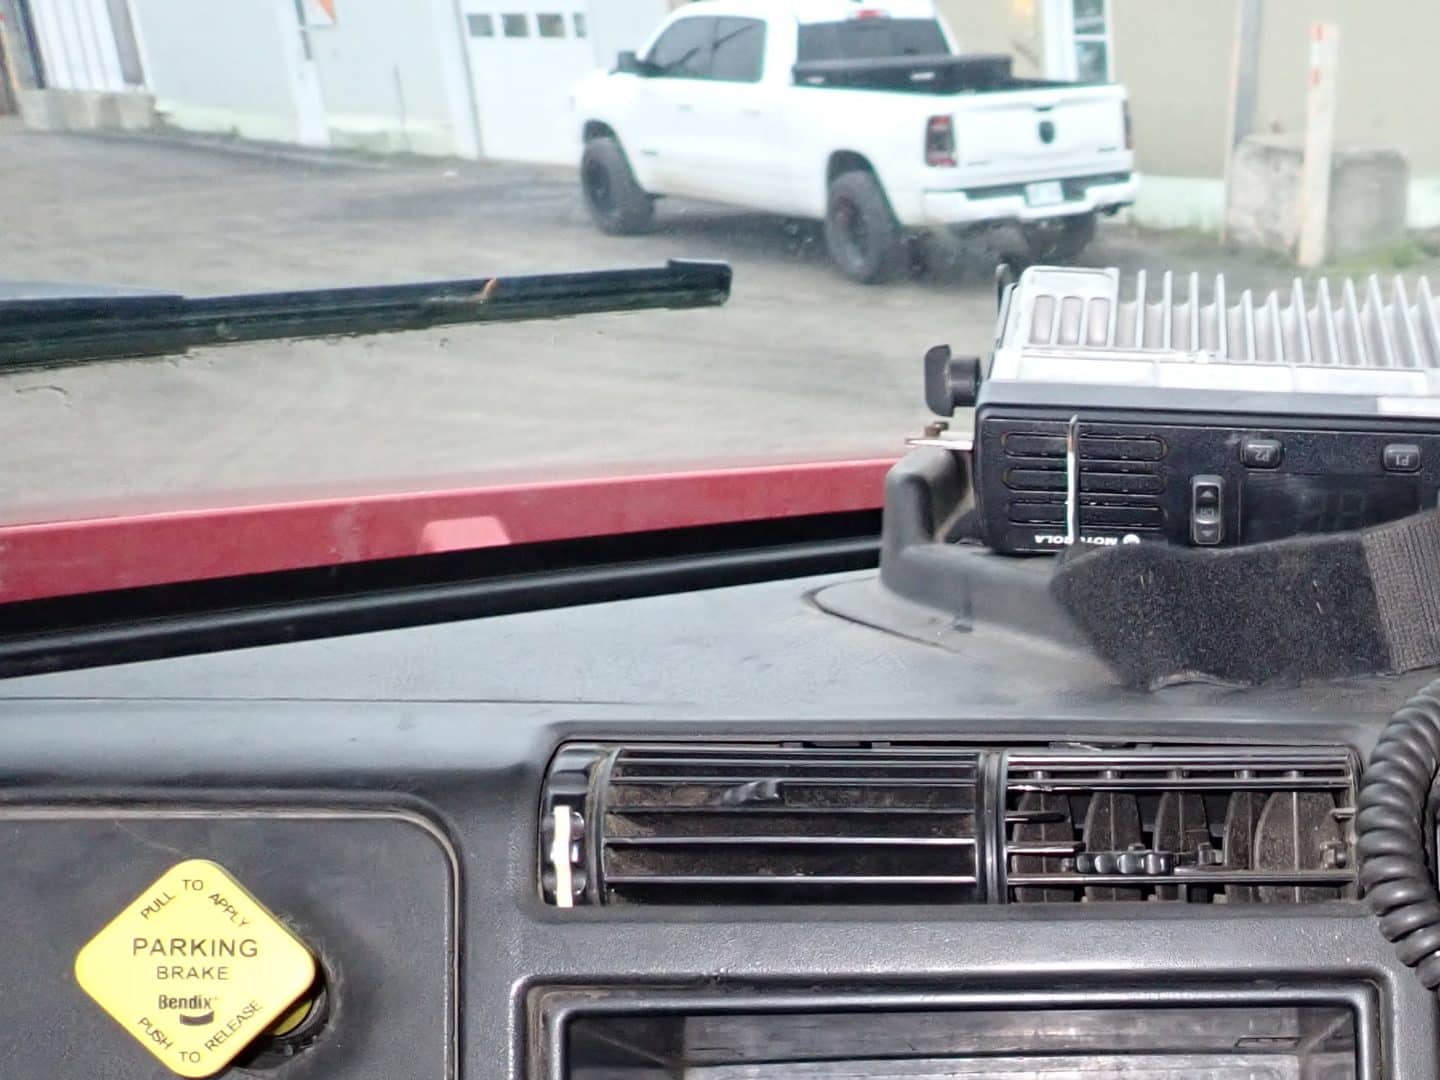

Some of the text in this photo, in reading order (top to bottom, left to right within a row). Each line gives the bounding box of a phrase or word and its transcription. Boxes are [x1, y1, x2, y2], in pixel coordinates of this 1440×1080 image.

[140, 878, 250, 928] PULL TO APPLY
[132, 937, 259, 958] PARKING
[156, 965, 230, 981] BRAKE
[158, 994, 213, 1010] Bendix
[138, 1000, 264, 1064] PUSH TO RELEASE
